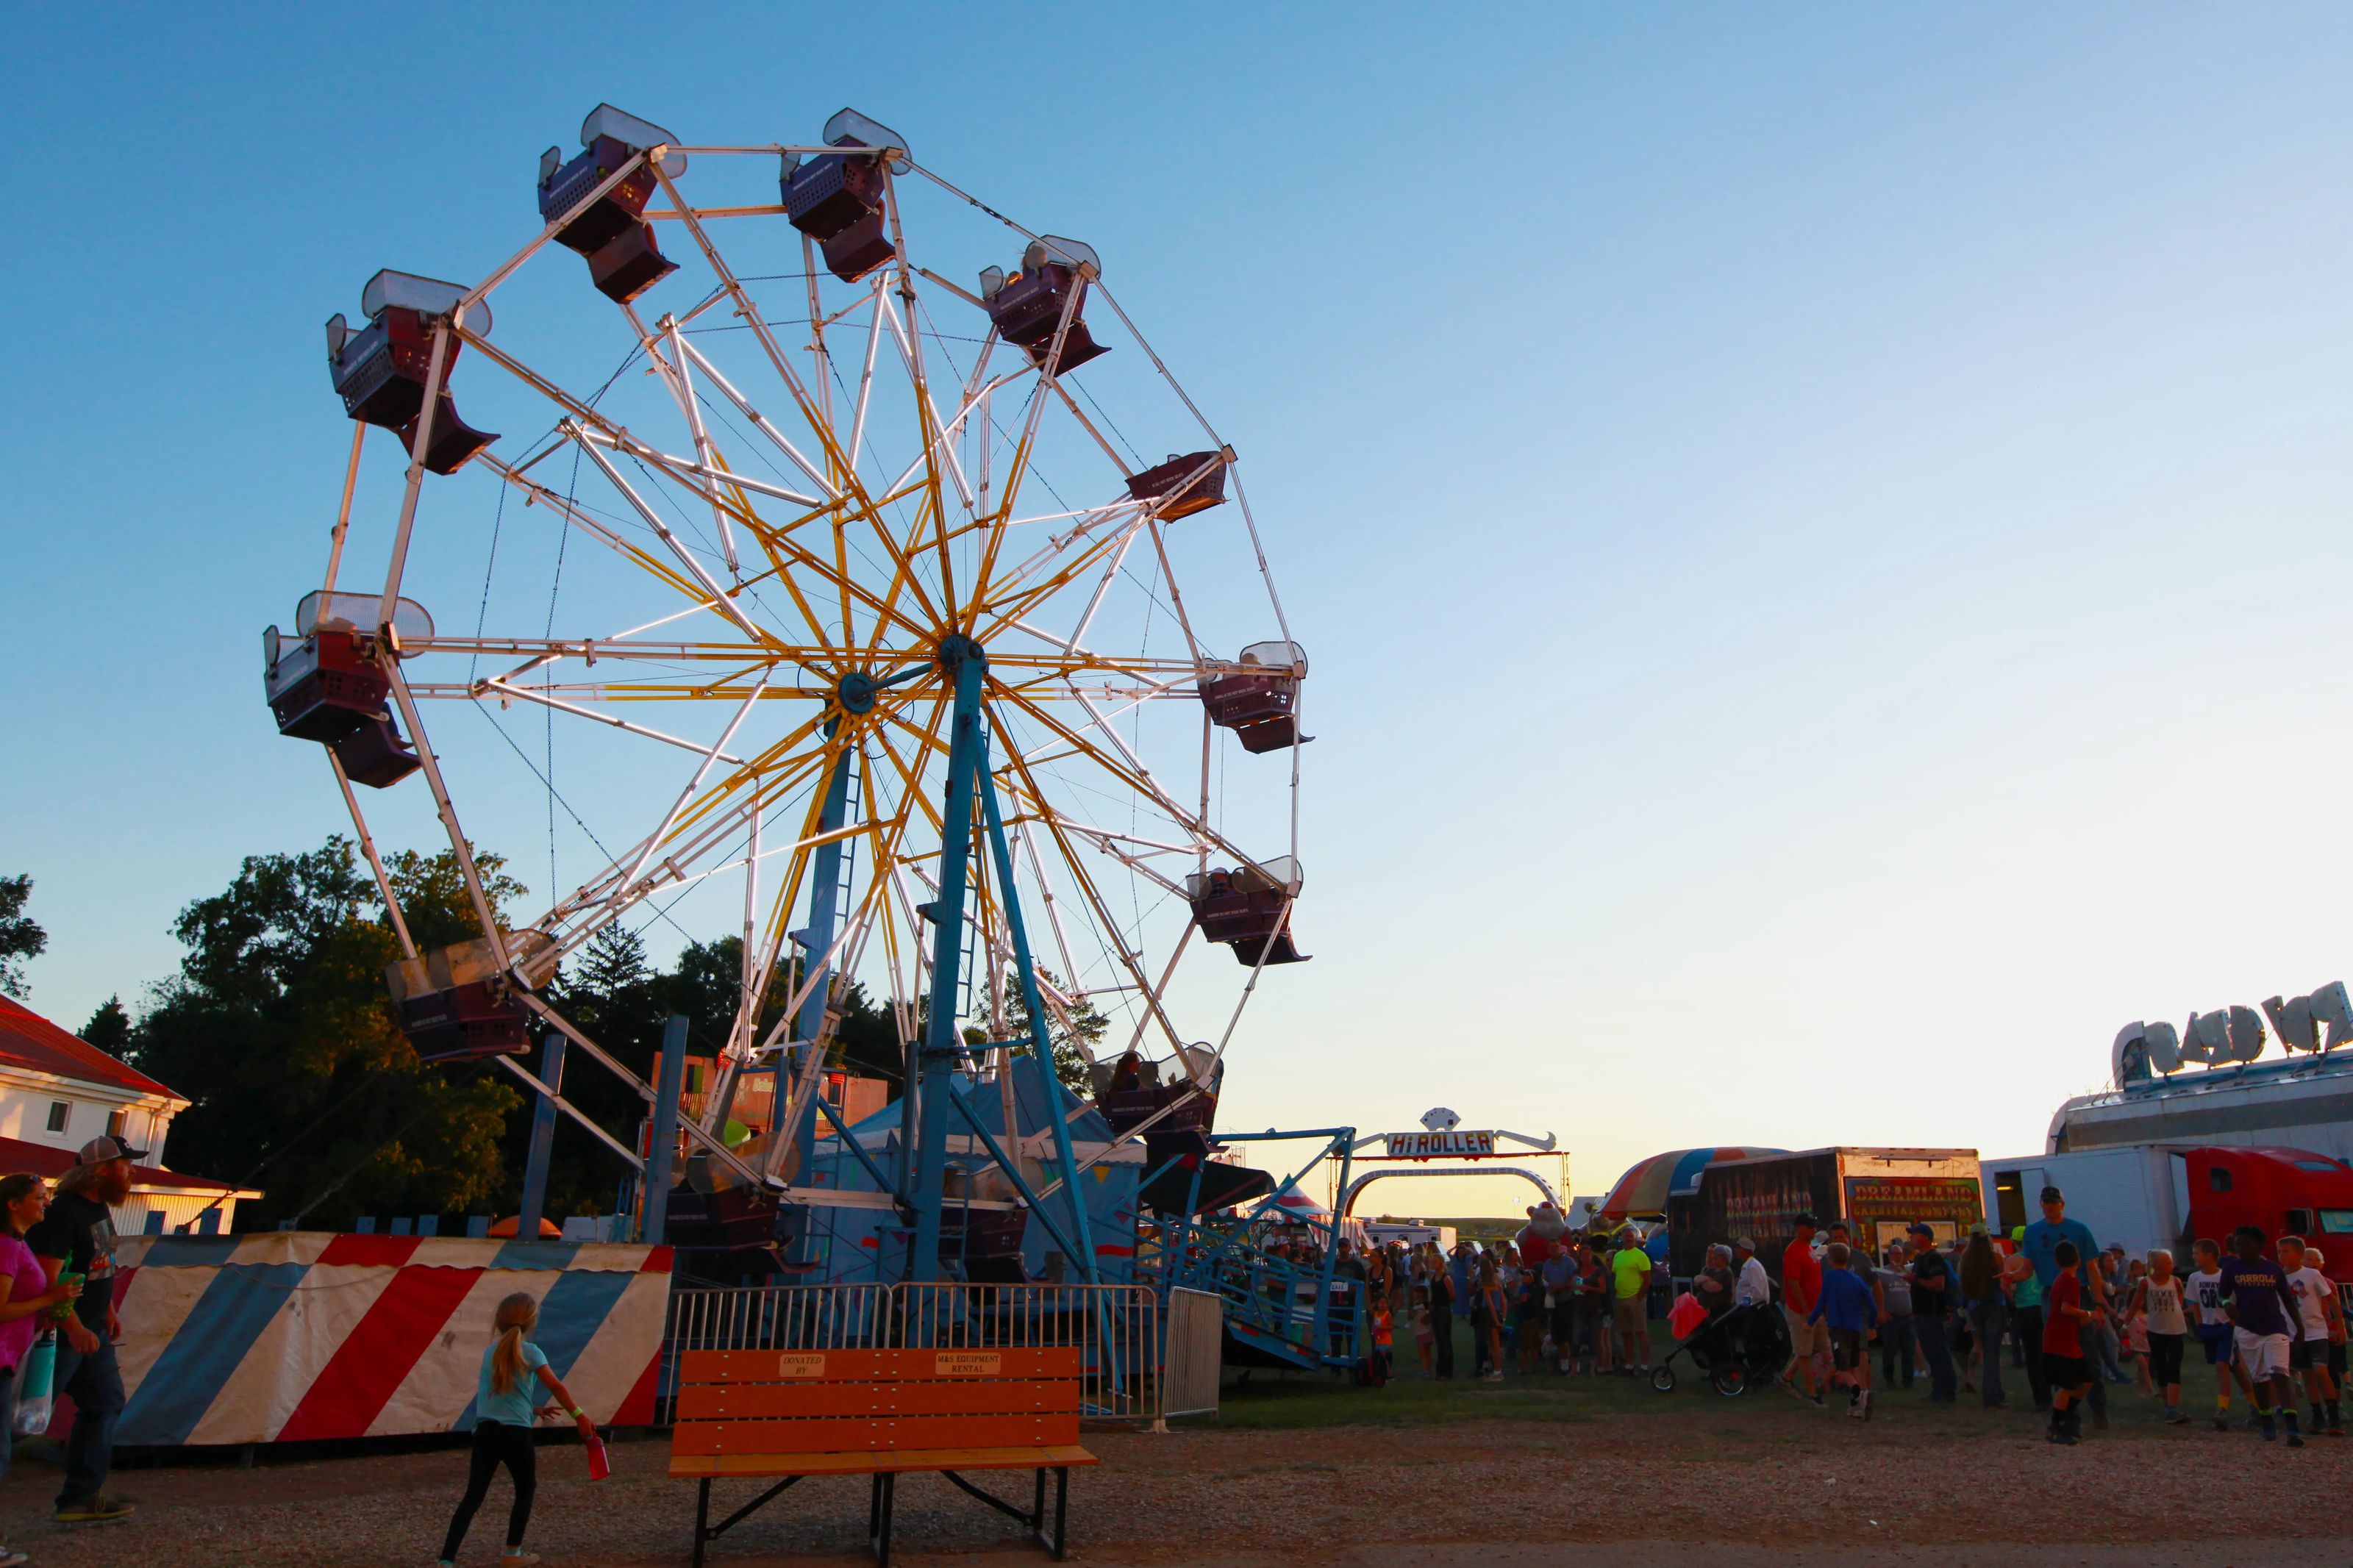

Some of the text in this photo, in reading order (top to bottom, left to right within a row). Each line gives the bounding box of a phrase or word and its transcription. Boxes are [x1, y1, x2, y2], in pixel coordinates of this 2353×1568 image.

[1416, 1133, 1492, 1153] ROLLER
[1854, 1184, 1973, 1202] DREAMLAND
[1853, 1205, 1975, 1217] CARNIVAL COMPANY
[2234, 1273, 2277, 1284] CARROLL
[783, 1356, 822, 1365] DONATED
[938, 1355, 999, 1363] M&S EQUIPMENT
[796, 1367, 808, 1375] BY
[951, 1365, 985, 1373] RENTAL
